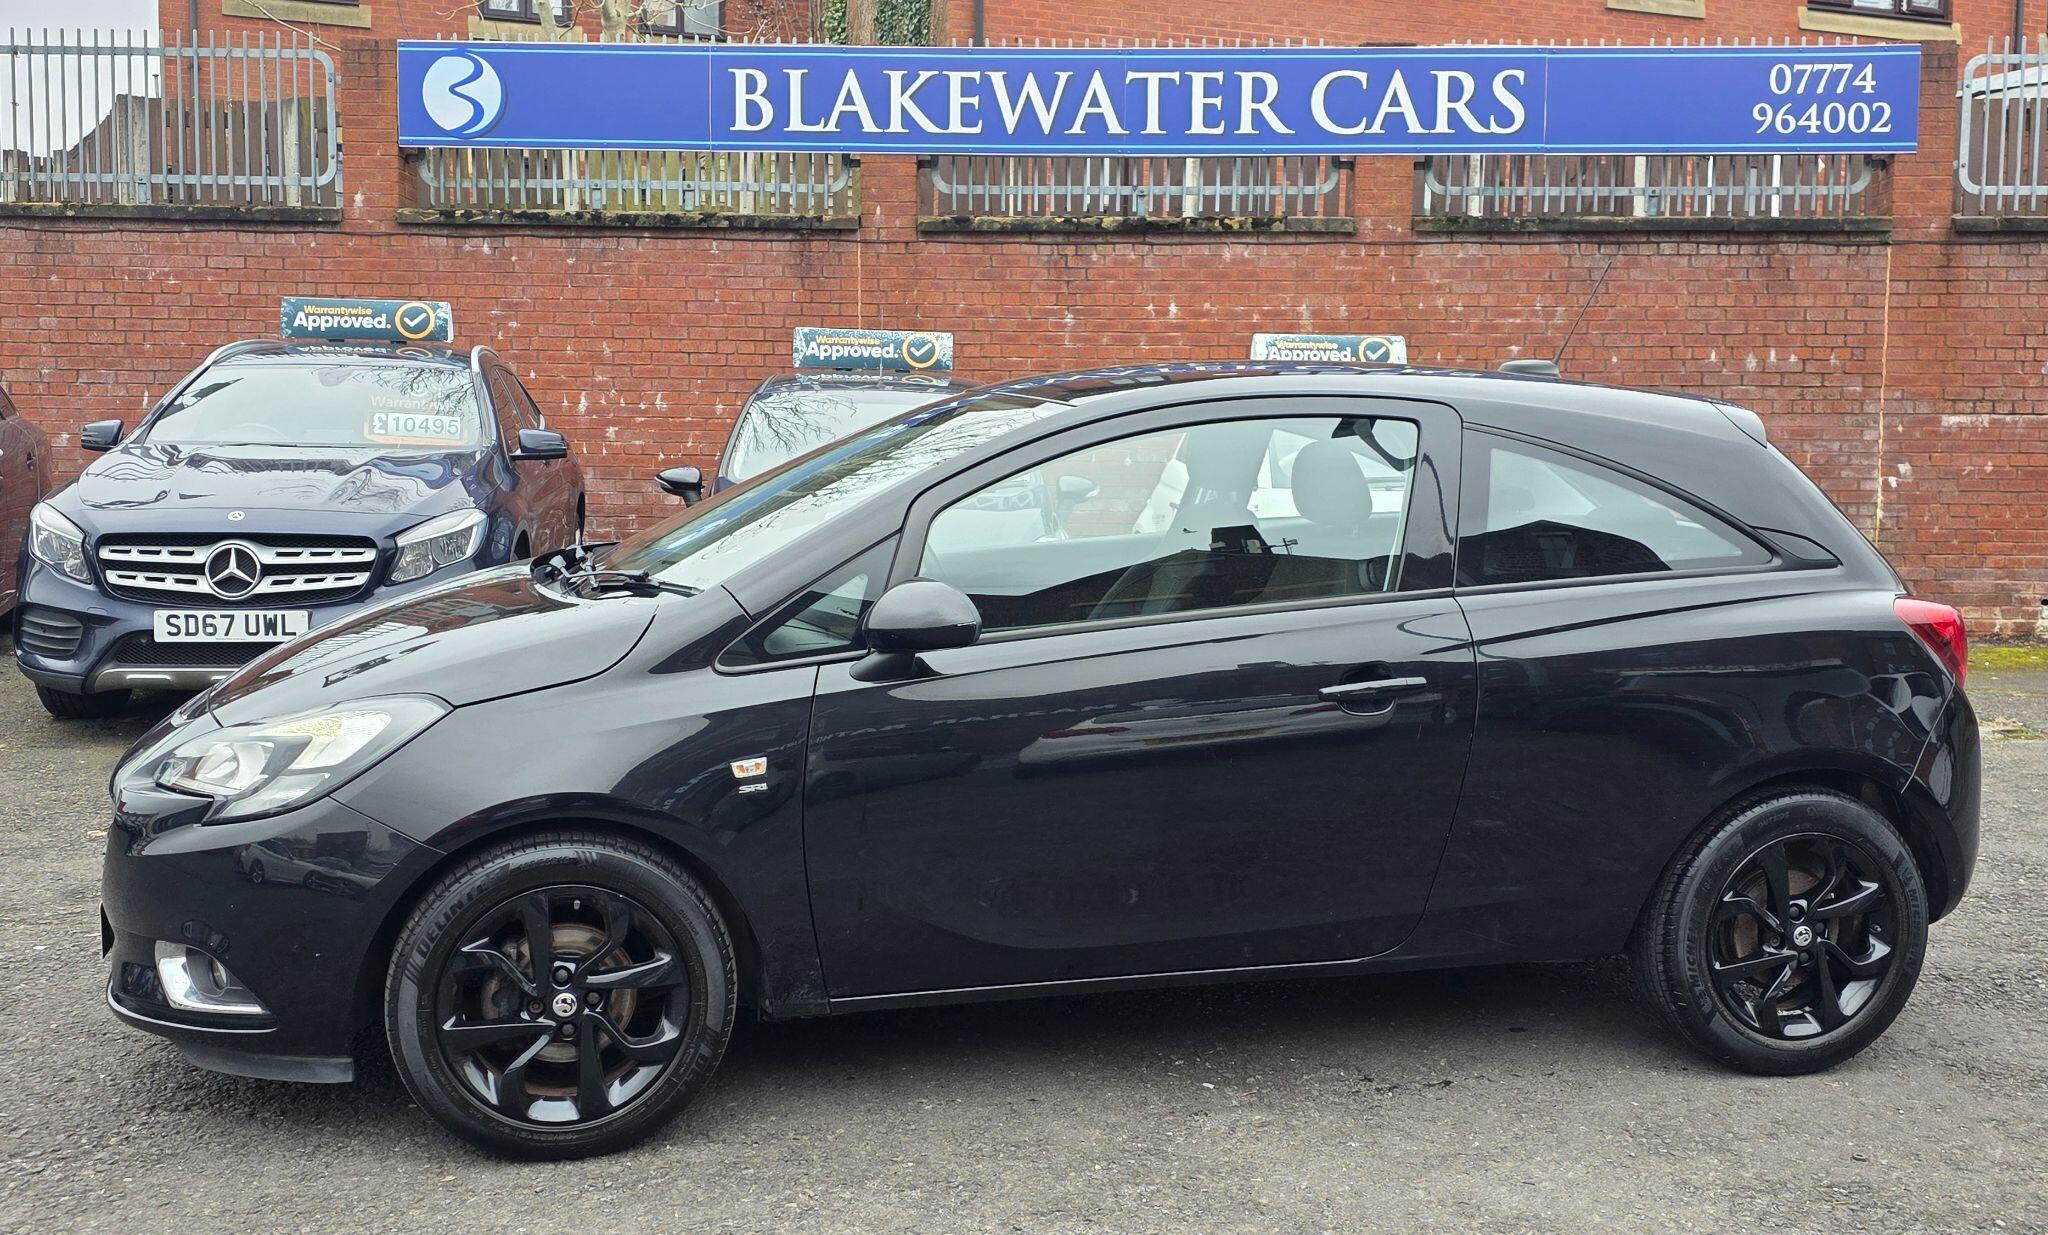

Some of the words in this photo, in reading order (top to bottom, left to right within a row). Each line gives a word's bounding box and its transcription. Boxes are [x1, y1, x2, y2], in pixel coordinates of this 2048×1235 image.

[1768, 62, 1877, 95] 07774
[728, 67, 1296, 136] BLAKEWATER
[1310, 67, 1526, 136] CARS
[1752, 102, 1892, 135] 964002
[304, 305, 372, 315] Warrantywise
[292, 311, 392, 332] Approved.
[804, 341, 899, 361] Approved.
[815, 335, 880, 346] Warrantywise
[1268, 346, 1357, 362] Approved.
[166, 613, 235, 637] SD67
[245, 613, 296, 637] UWL
